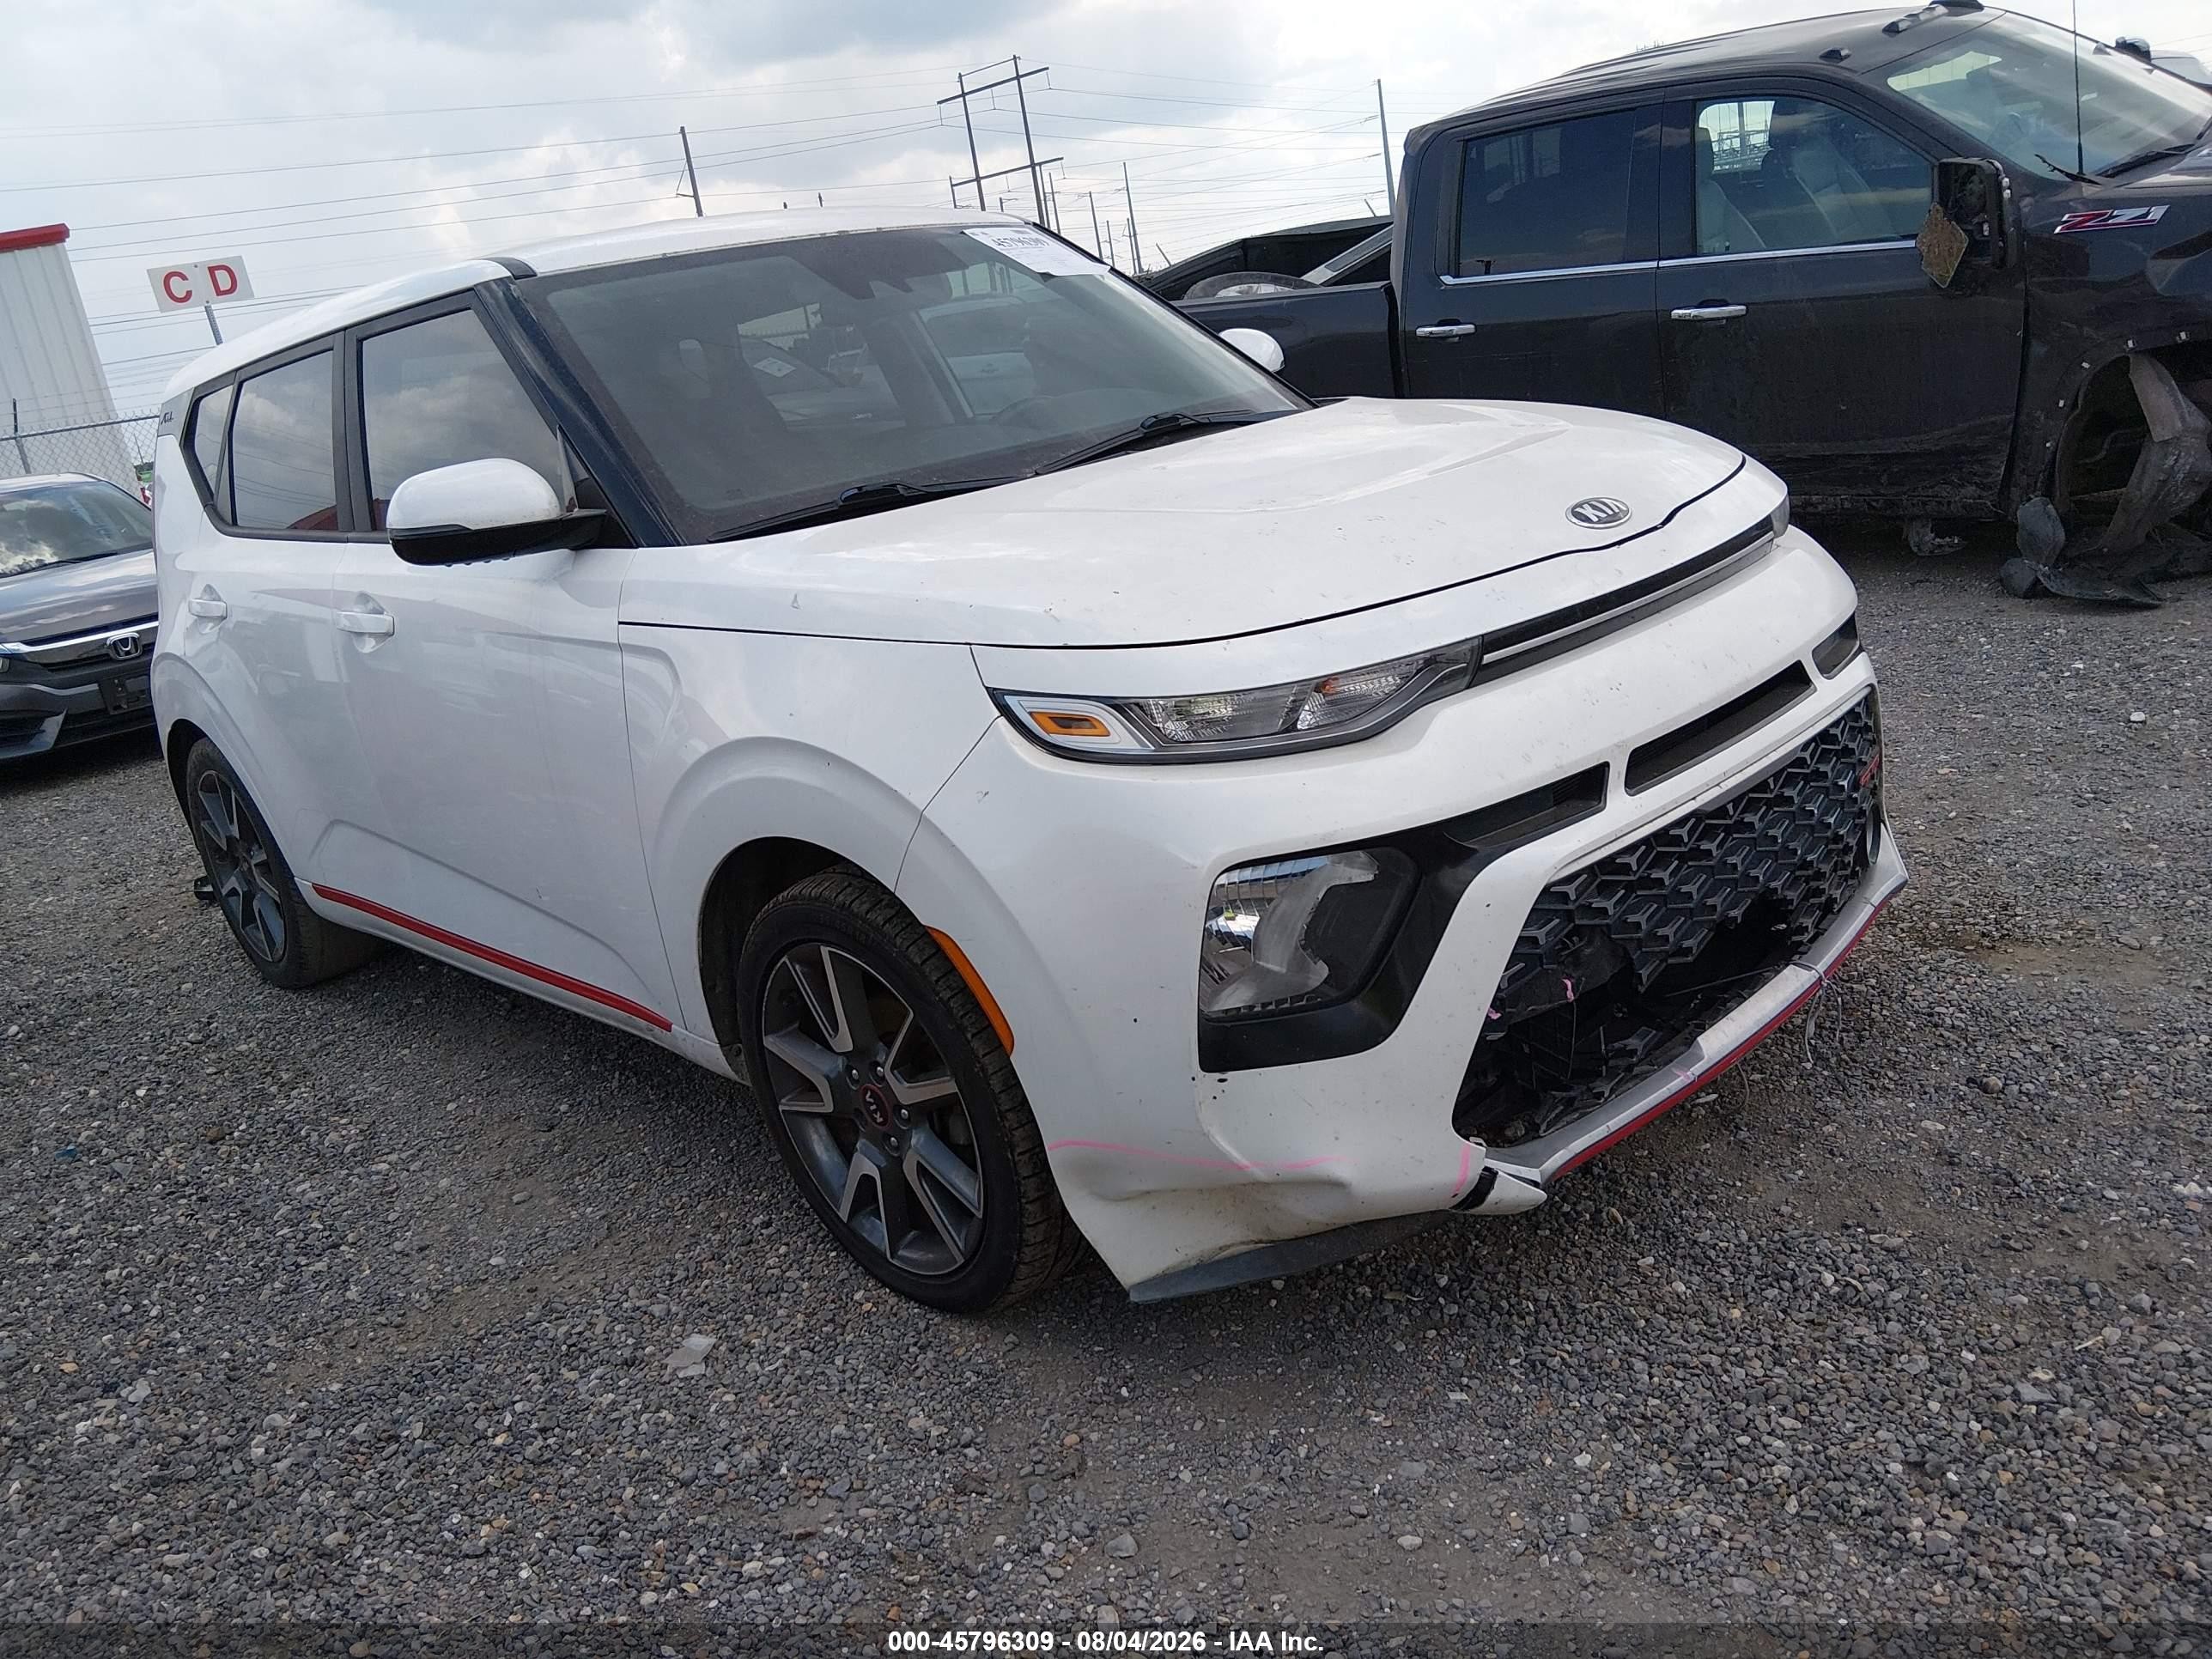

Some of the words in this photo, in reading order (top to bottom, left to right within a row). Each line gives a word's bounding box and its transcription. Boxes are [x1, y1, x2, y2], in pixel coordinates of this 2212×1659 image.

[2053, 204, 2171, 234] Z71
[163, 270, 193, 304] C
[207, 264, 238, 297] D
[1572, 498, 1629, 523] KIA
[865, 1089, 884, 1123] KIA
